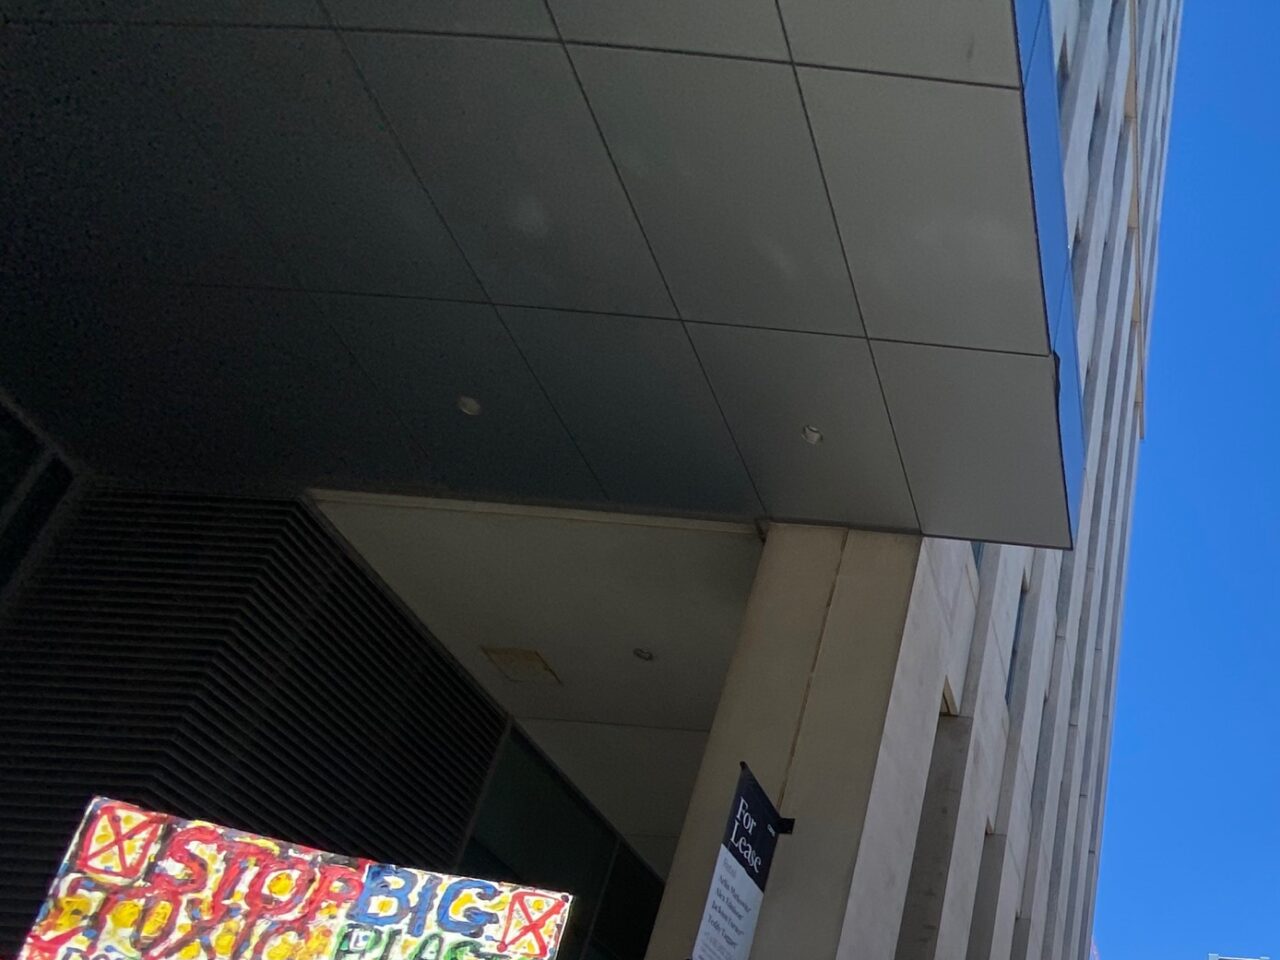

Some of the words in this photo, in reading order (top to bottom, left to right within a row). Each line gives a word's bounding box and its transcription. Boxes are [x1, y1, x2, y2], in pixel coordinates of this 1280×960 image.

[737, 796, 756, 835] For
[730, 820, 761, 873] Lease
[152, 825, 365, 924] STOP
[346, 864, 504, 937] BIG
